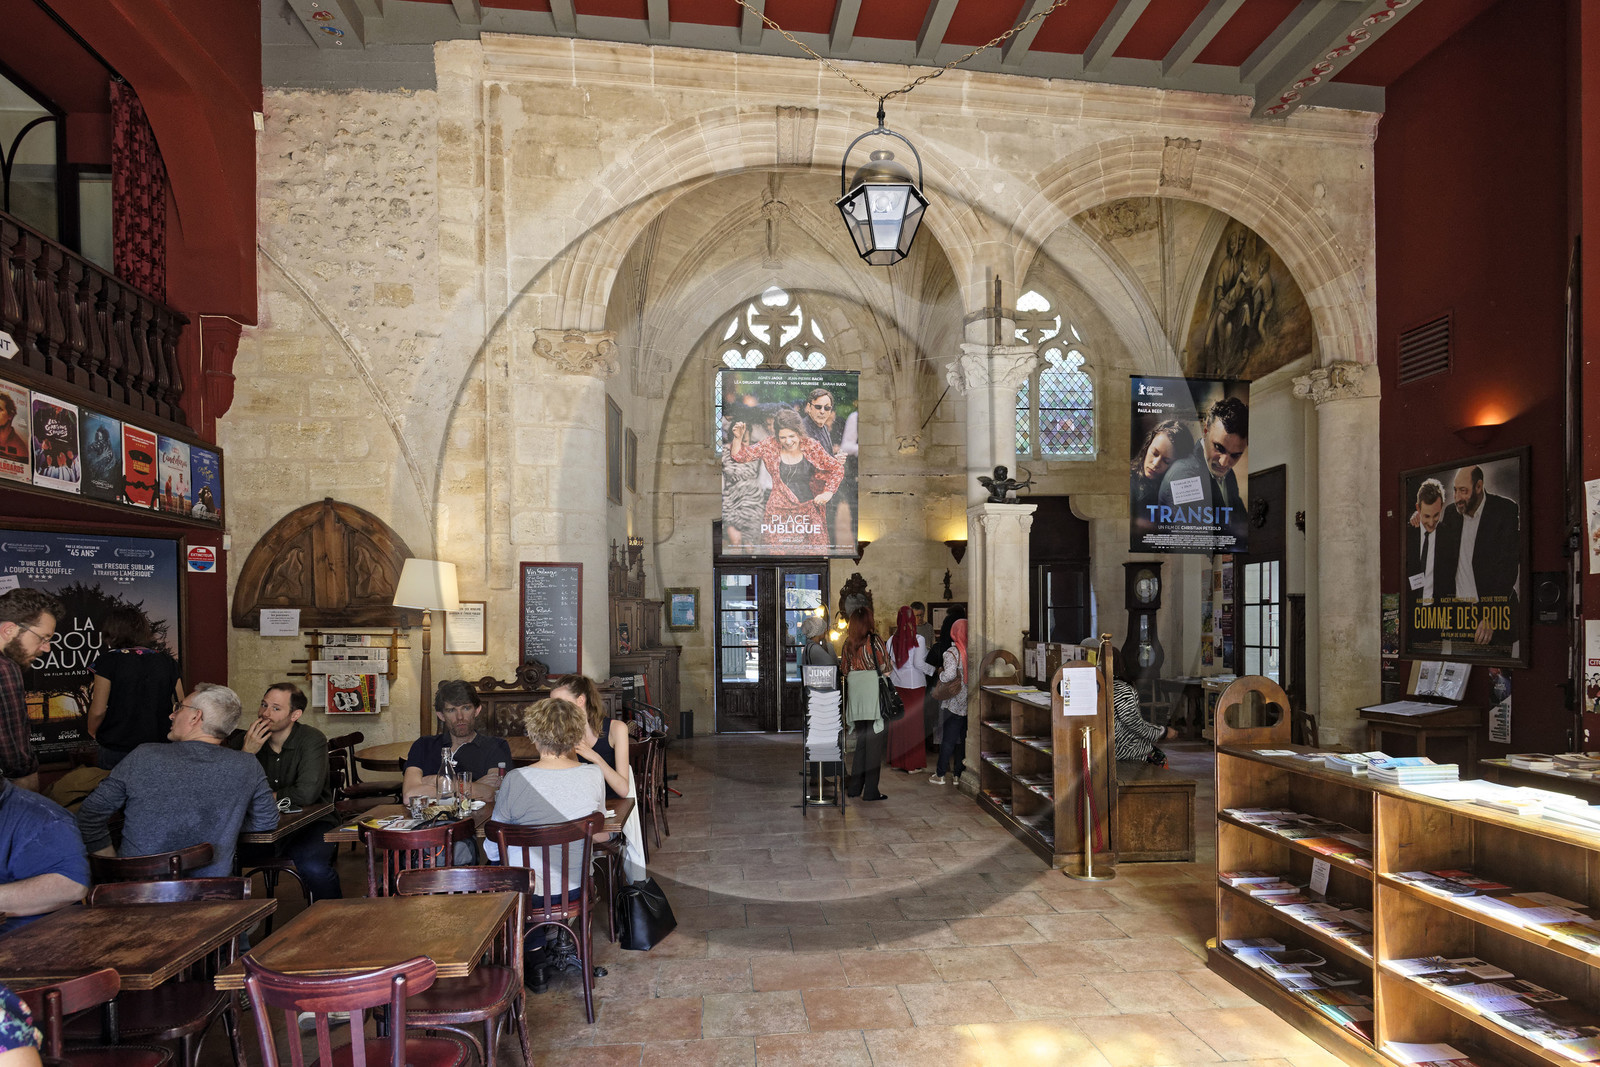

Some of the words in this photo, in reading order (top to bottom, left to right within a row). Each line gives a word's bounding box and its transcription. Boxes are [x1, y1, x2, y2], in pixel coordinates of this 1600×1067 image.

[771, 515, 810, 524] PLACE
[1146, 505, 1233, 524] TRANSIT
[760, 524, 821, 534] PUBLIQUE
[38, 559, 62, 568] BEAUTÉ
[74, 617, 94, 630] LA
[1414, 606, 1453, 629] COMME
[1457, 606, 1478, 629] DES
[1482, 606, 1510, 630] ROIS
[49, 632, 102, 650] ROU
